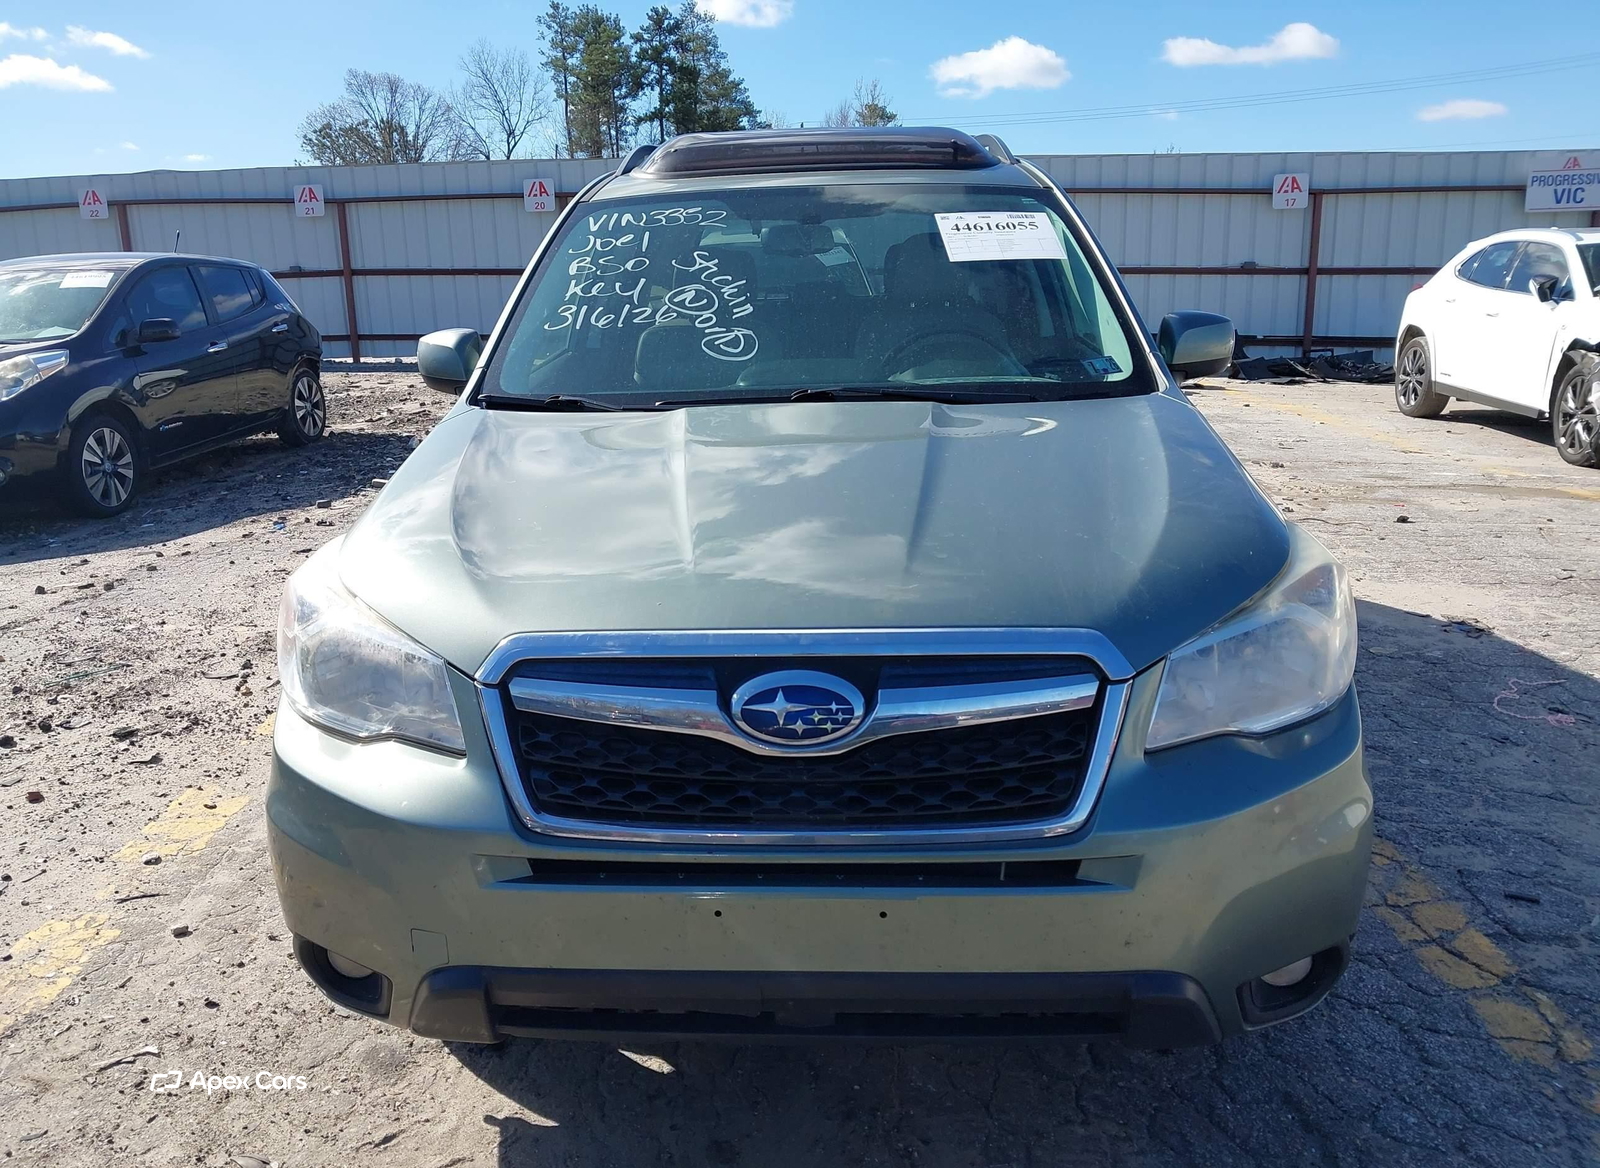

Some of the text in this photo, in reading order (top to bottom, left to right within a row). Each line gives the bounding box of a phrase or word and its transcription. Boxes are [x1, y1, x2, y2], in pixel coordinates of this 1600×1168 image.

[1554, 187, 1585, 204] VIC
[534, 201, 546, 210] 20
[1285, 198, 1297, 207] 17
[89, 209, 100, 218] 22
[304, 207, 315, 215] 21
[950, 221, 1039, 232] 44616055
